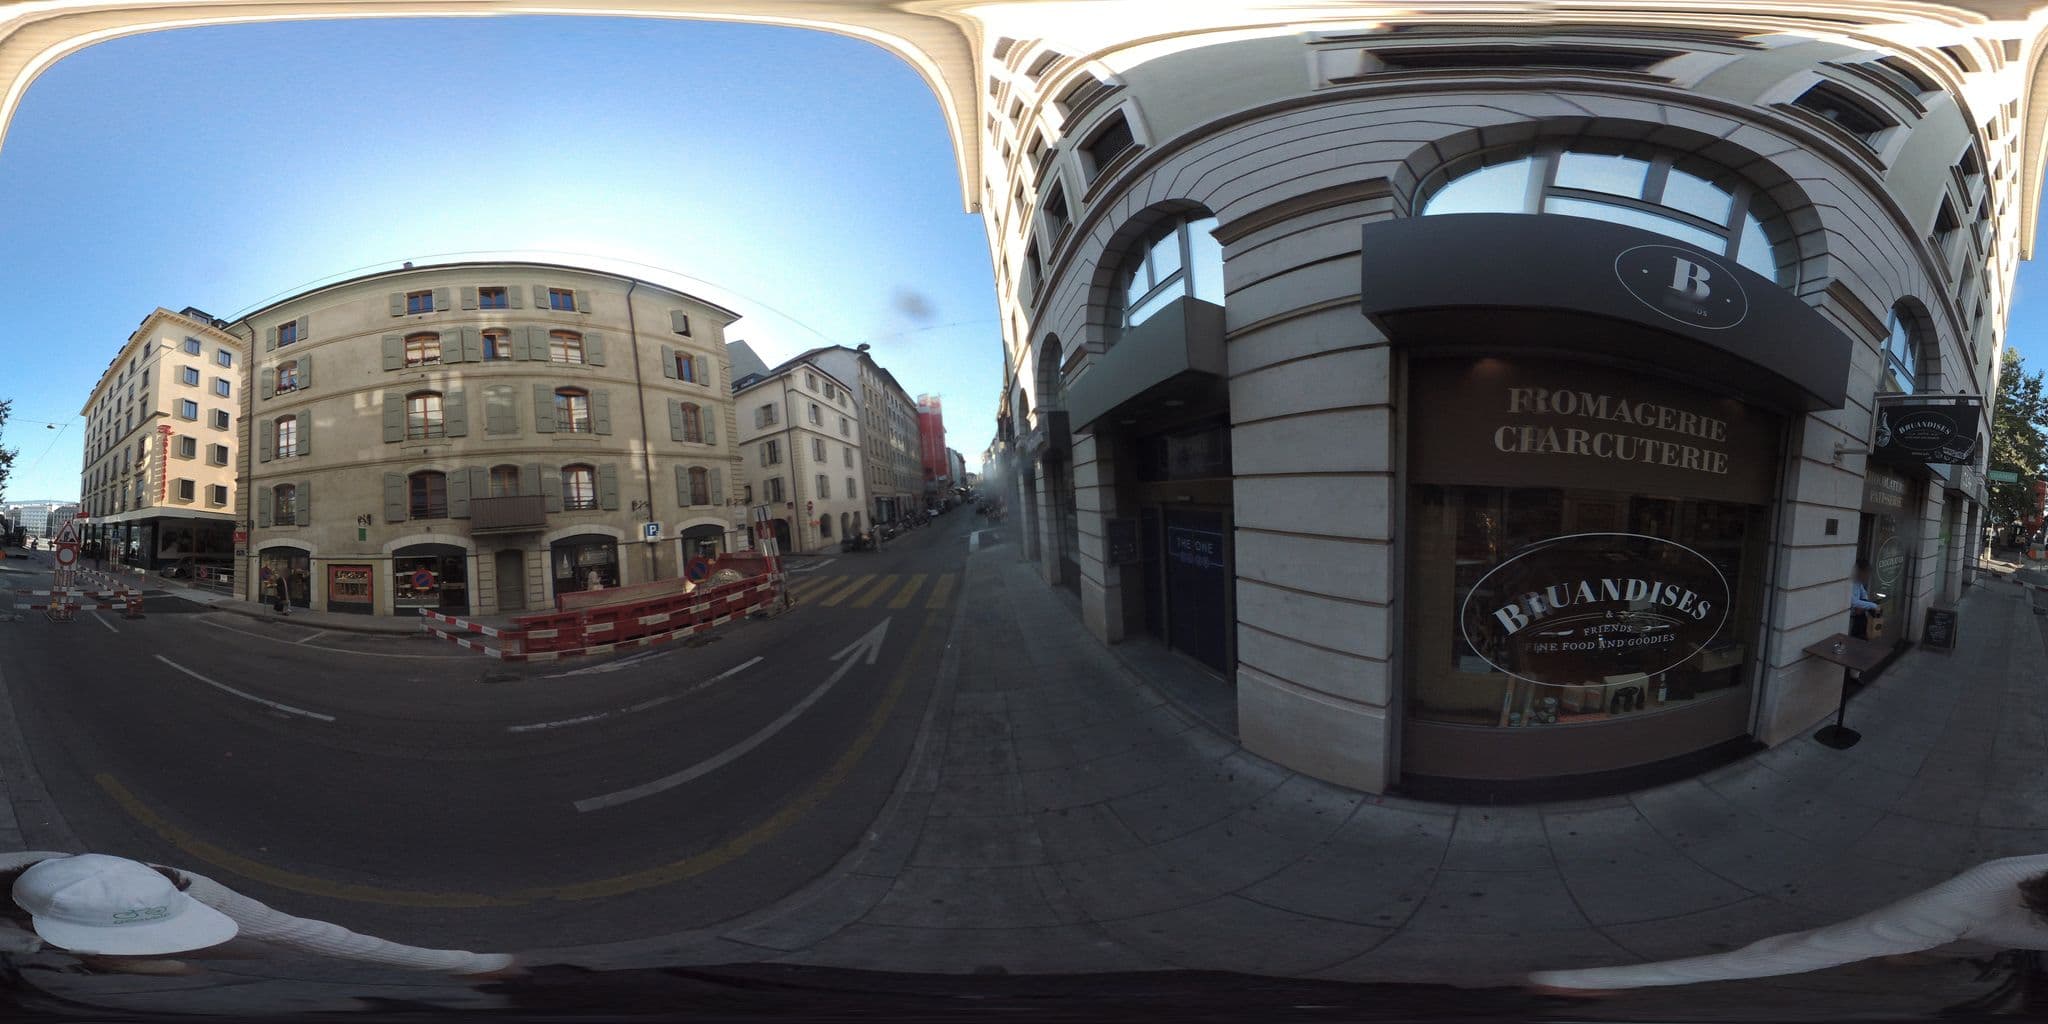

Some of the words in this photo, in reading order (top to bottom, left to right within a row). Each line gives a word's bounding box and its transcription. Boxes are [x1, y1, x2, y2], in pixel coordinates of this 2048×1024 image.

[1667, 256, 1712, 299] B
[1507, 387, 1727, 442] FROMAGERIE
[1899, 421, 1950, 435] BRUANDISES
[1494, 426, 1729, 475] CHARCUTERIE
[1491, 577, 1712, 636] BRUANDISES
[1562, 640, 1596, 651] FOOD
[1598, 637, 1625, 650] AND
[1627, 633, 1676, 647] GOODIES
[1583, 623, 1633, 637] FRIENDS
